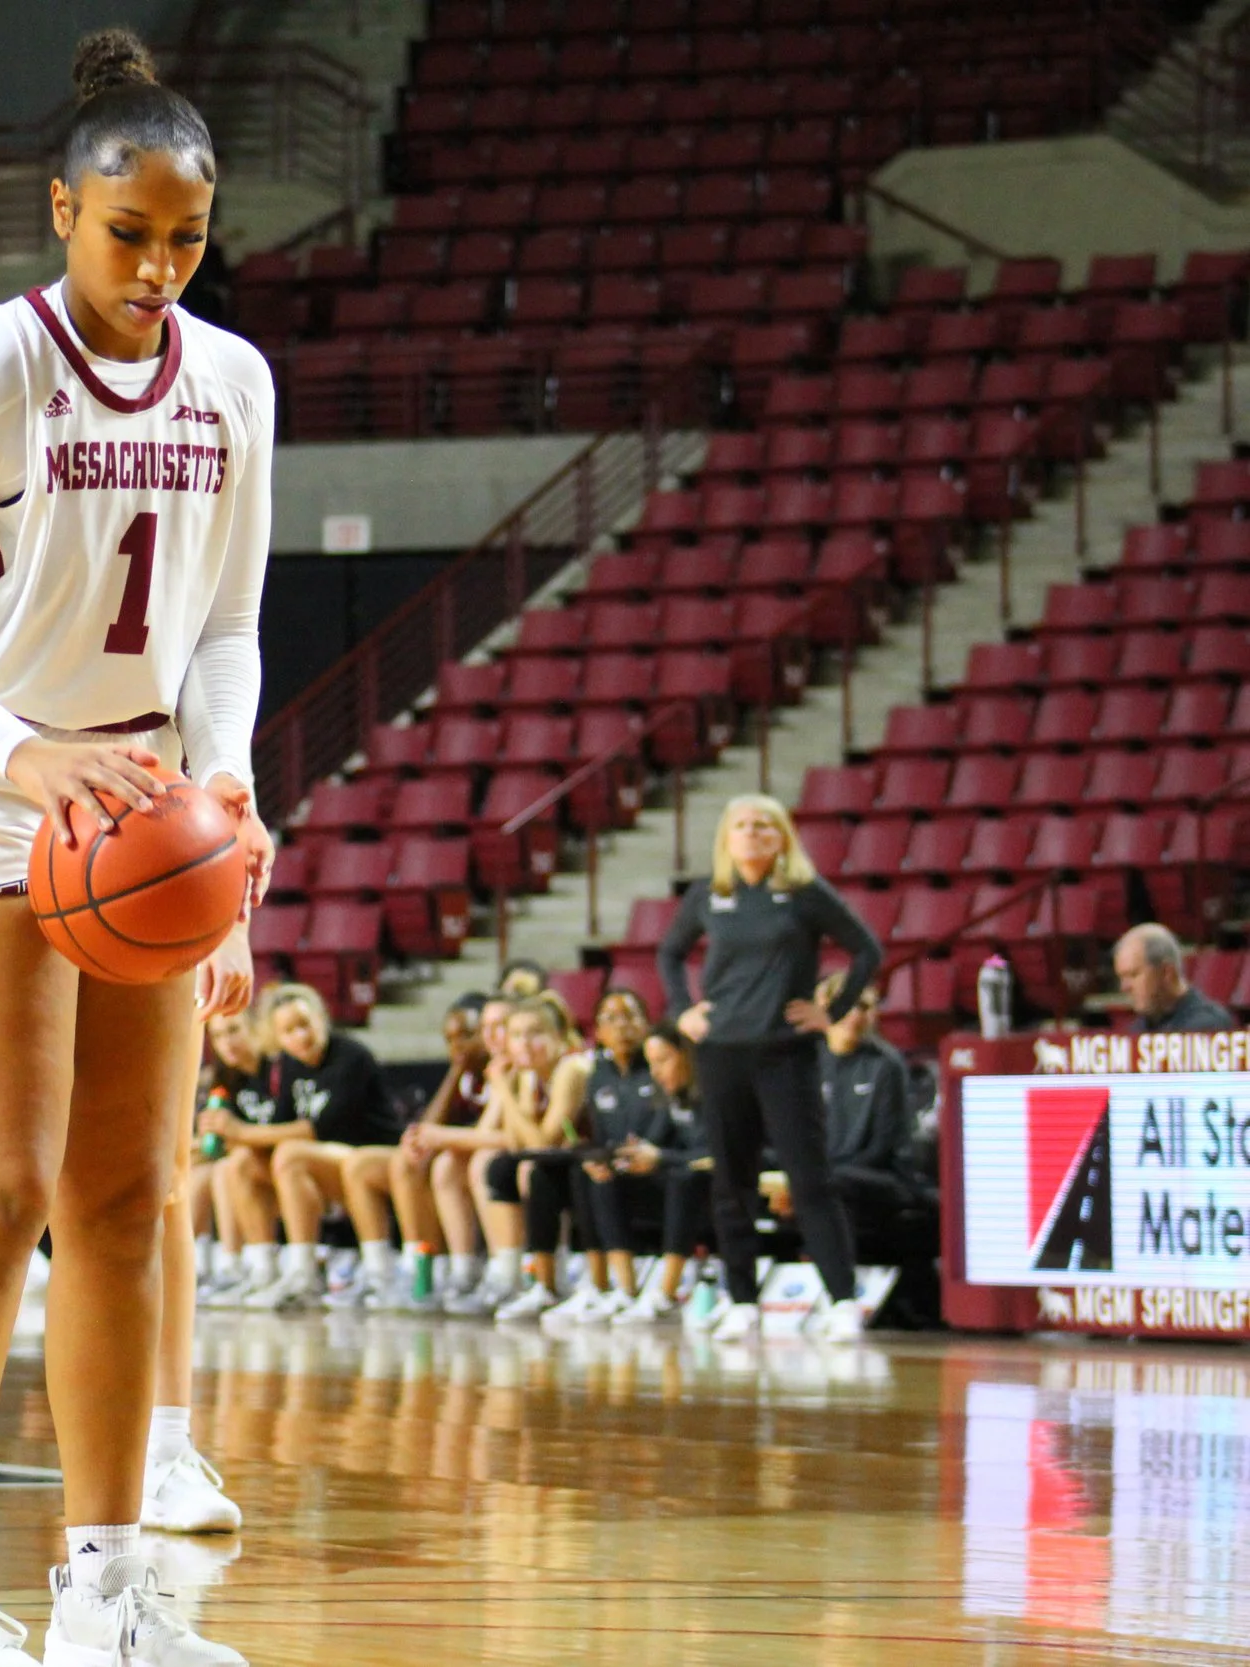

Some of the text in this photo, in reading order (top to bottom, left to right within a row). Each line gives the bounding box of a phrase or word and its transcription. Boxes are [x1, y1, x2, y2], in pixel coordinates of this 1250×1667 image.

[171, 405, 220, 425] A10
[104, 512, 158, 655] 1
[1071, 1034, 1131, 1074] MGM
[1137, 1096, 1185, 1168] All
[1076, 1286, 1134, 1325] MGM
